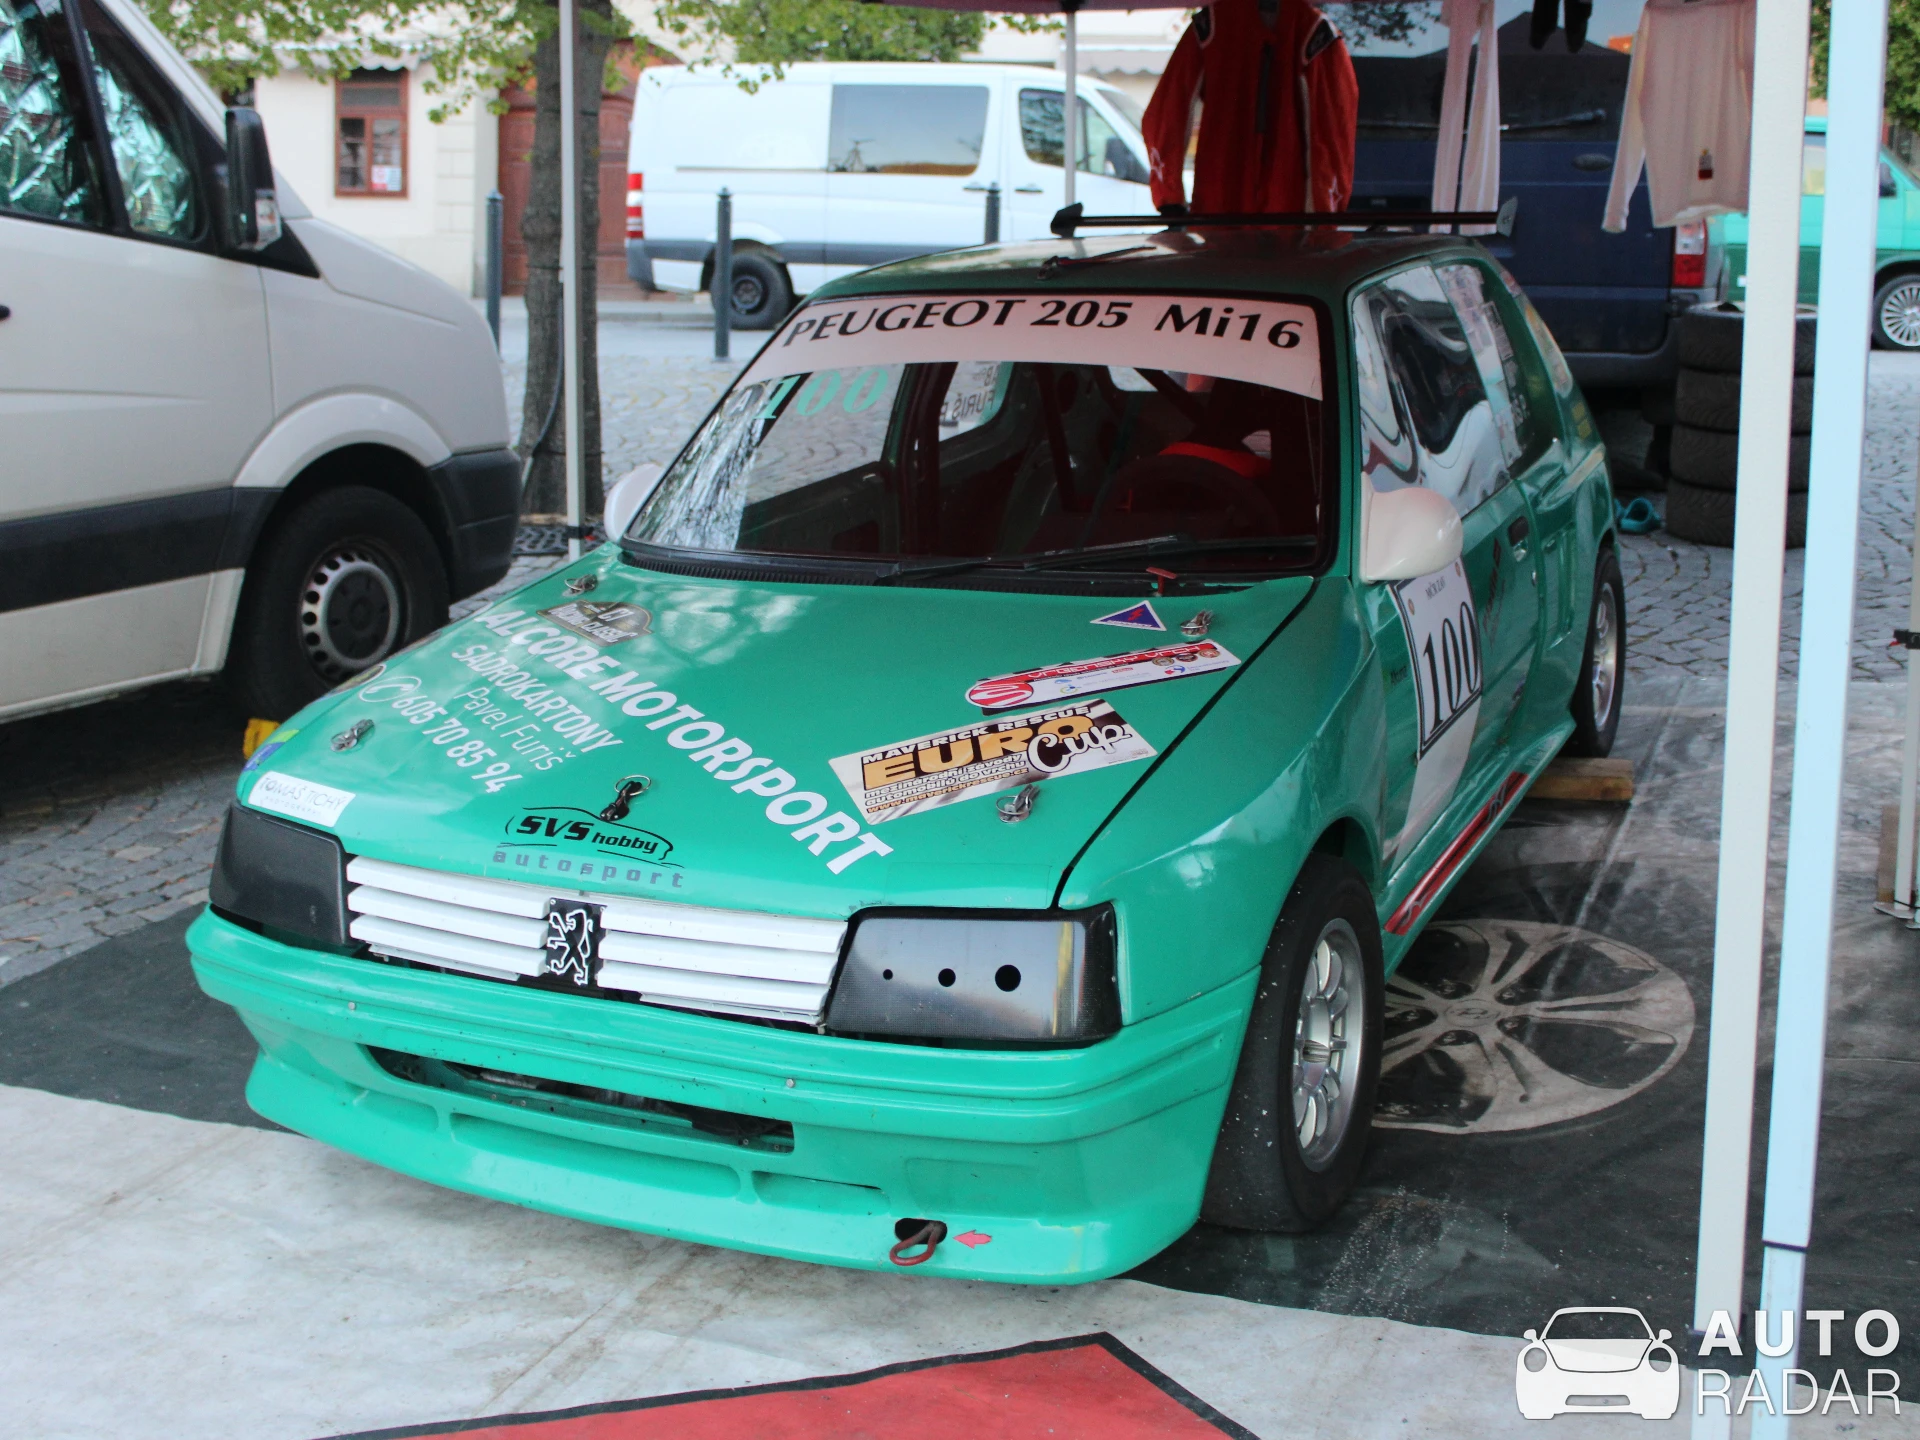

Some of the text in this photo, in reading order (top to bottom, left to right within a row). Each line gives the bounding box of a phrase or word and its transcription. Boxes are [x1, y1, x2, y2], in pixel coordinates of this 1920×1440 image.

[783, 300, 1304, 349] PEUGEOT 205 Mi16
[754, 368, 889, 419] 100
[581, 621, 639, 643] CLASSIC
[1423, 601, 1479, 734] 100
[391, 695, 523, 794] 605 70 85 94
[453, 686, 577, 771] Pavel Furiš
[474, 610, 894, 875] ALCORE MOTORSPORT
[862, 705, 1091, 764] MAVERICK RESCUE
[863, 715, 1094, 791] EURO
[1027, 724, 1133, 774] Cup
[867, 768, 1029, 814] www.maverickrescue.cz
[959, 770, 981, 783] do
[981, 760, 1026, 777] vrchu
[516, 815, 658, 854] SVS hobby
[493, 851, 685, 888] autosport
